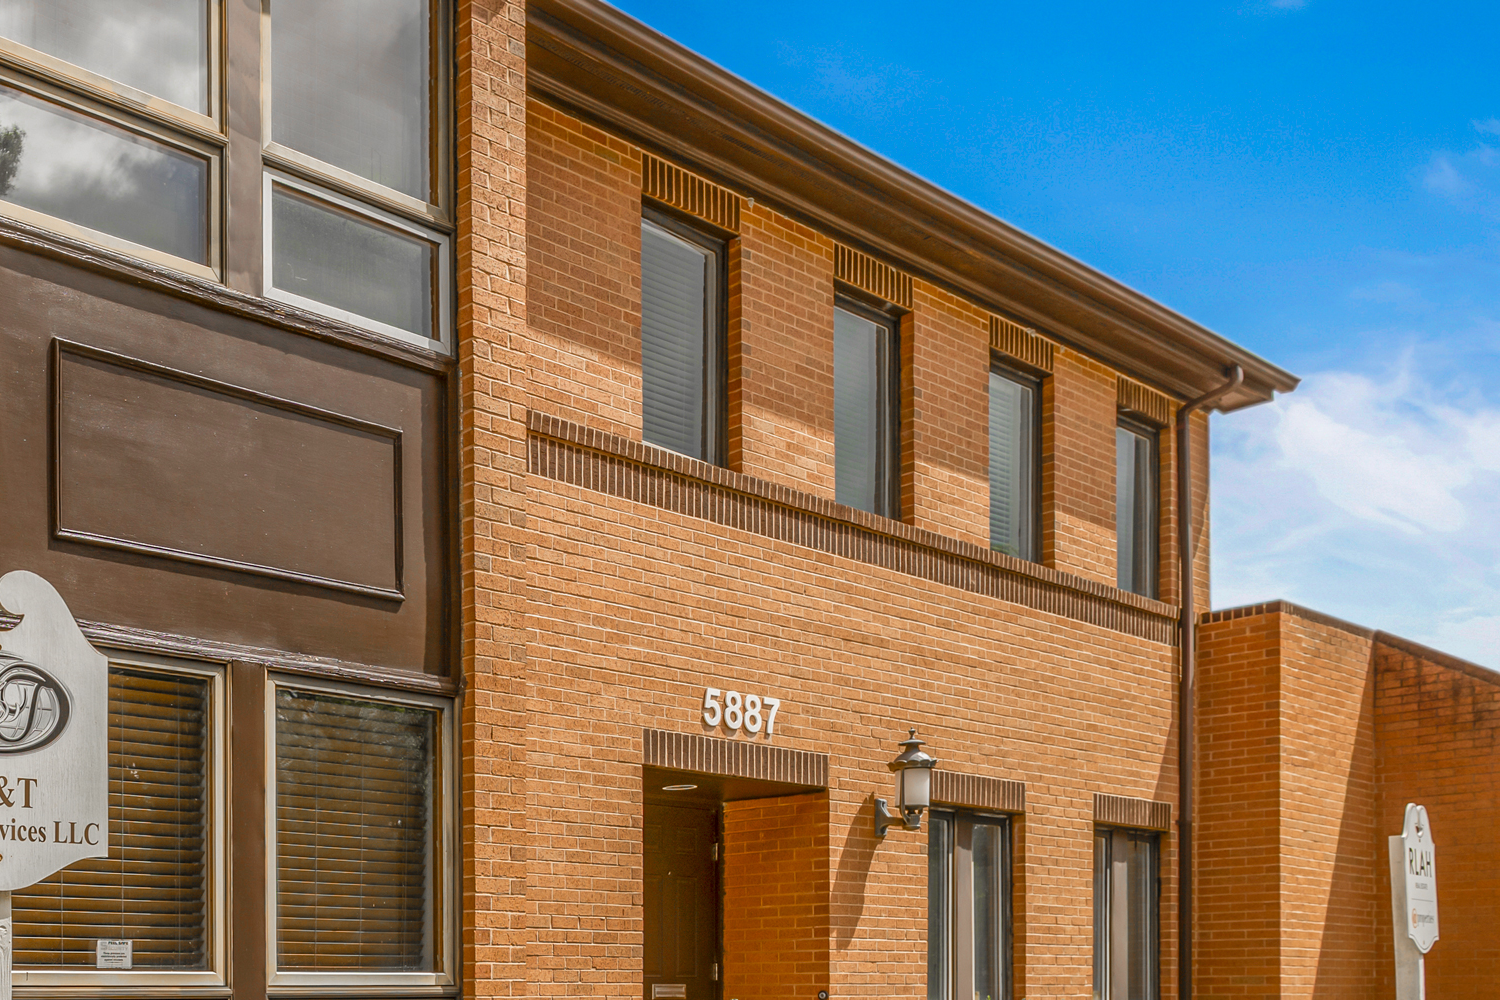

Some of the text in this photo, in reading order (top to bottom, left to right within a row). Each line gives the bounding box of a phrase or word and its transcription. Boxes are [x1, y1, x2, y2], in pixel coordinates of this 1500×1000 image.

[702, 687, 781, 734] 5887
[53, 821, 100, 846] LLC
[1408, 847, 1433, 878] RLAH
